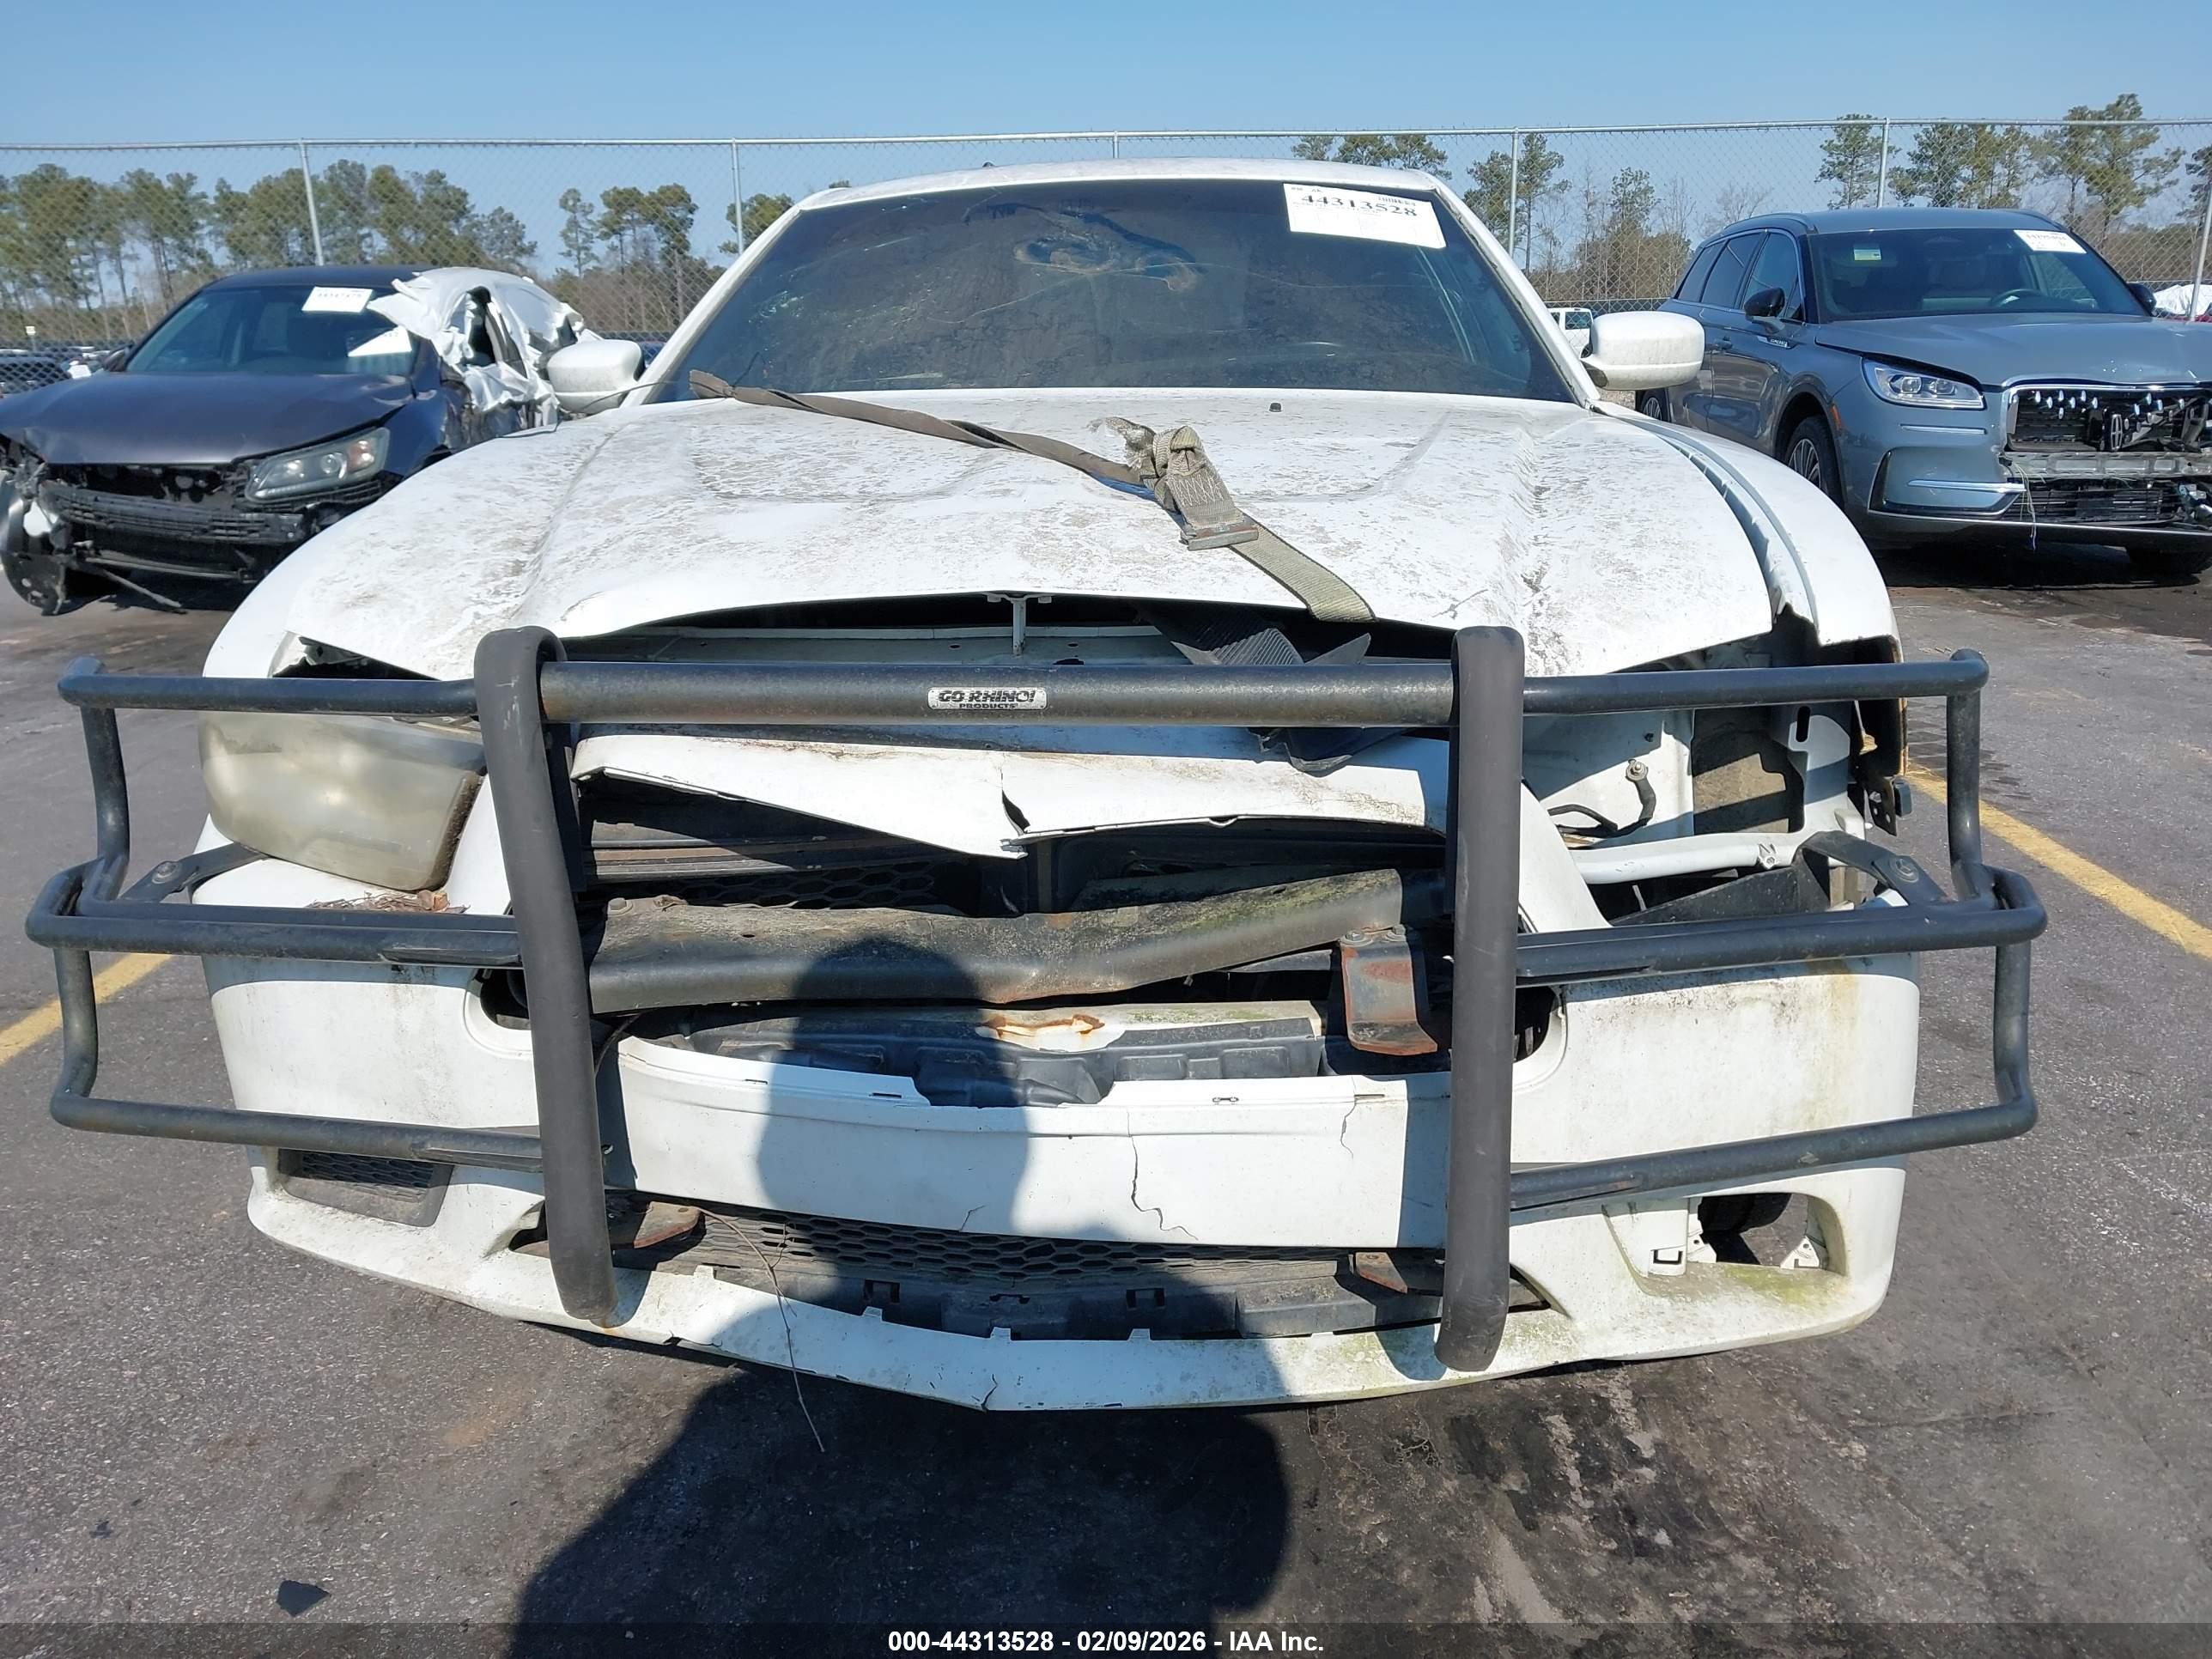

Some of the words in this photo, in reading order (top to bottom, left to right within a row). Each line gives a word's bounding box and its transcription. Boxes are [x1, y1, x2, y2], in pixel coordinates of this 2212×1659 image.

[1301, 194, 1418, 216] 44313528
[939, 690, 964, 702] GO
[968, 690, 1036, 702] RHINO!
